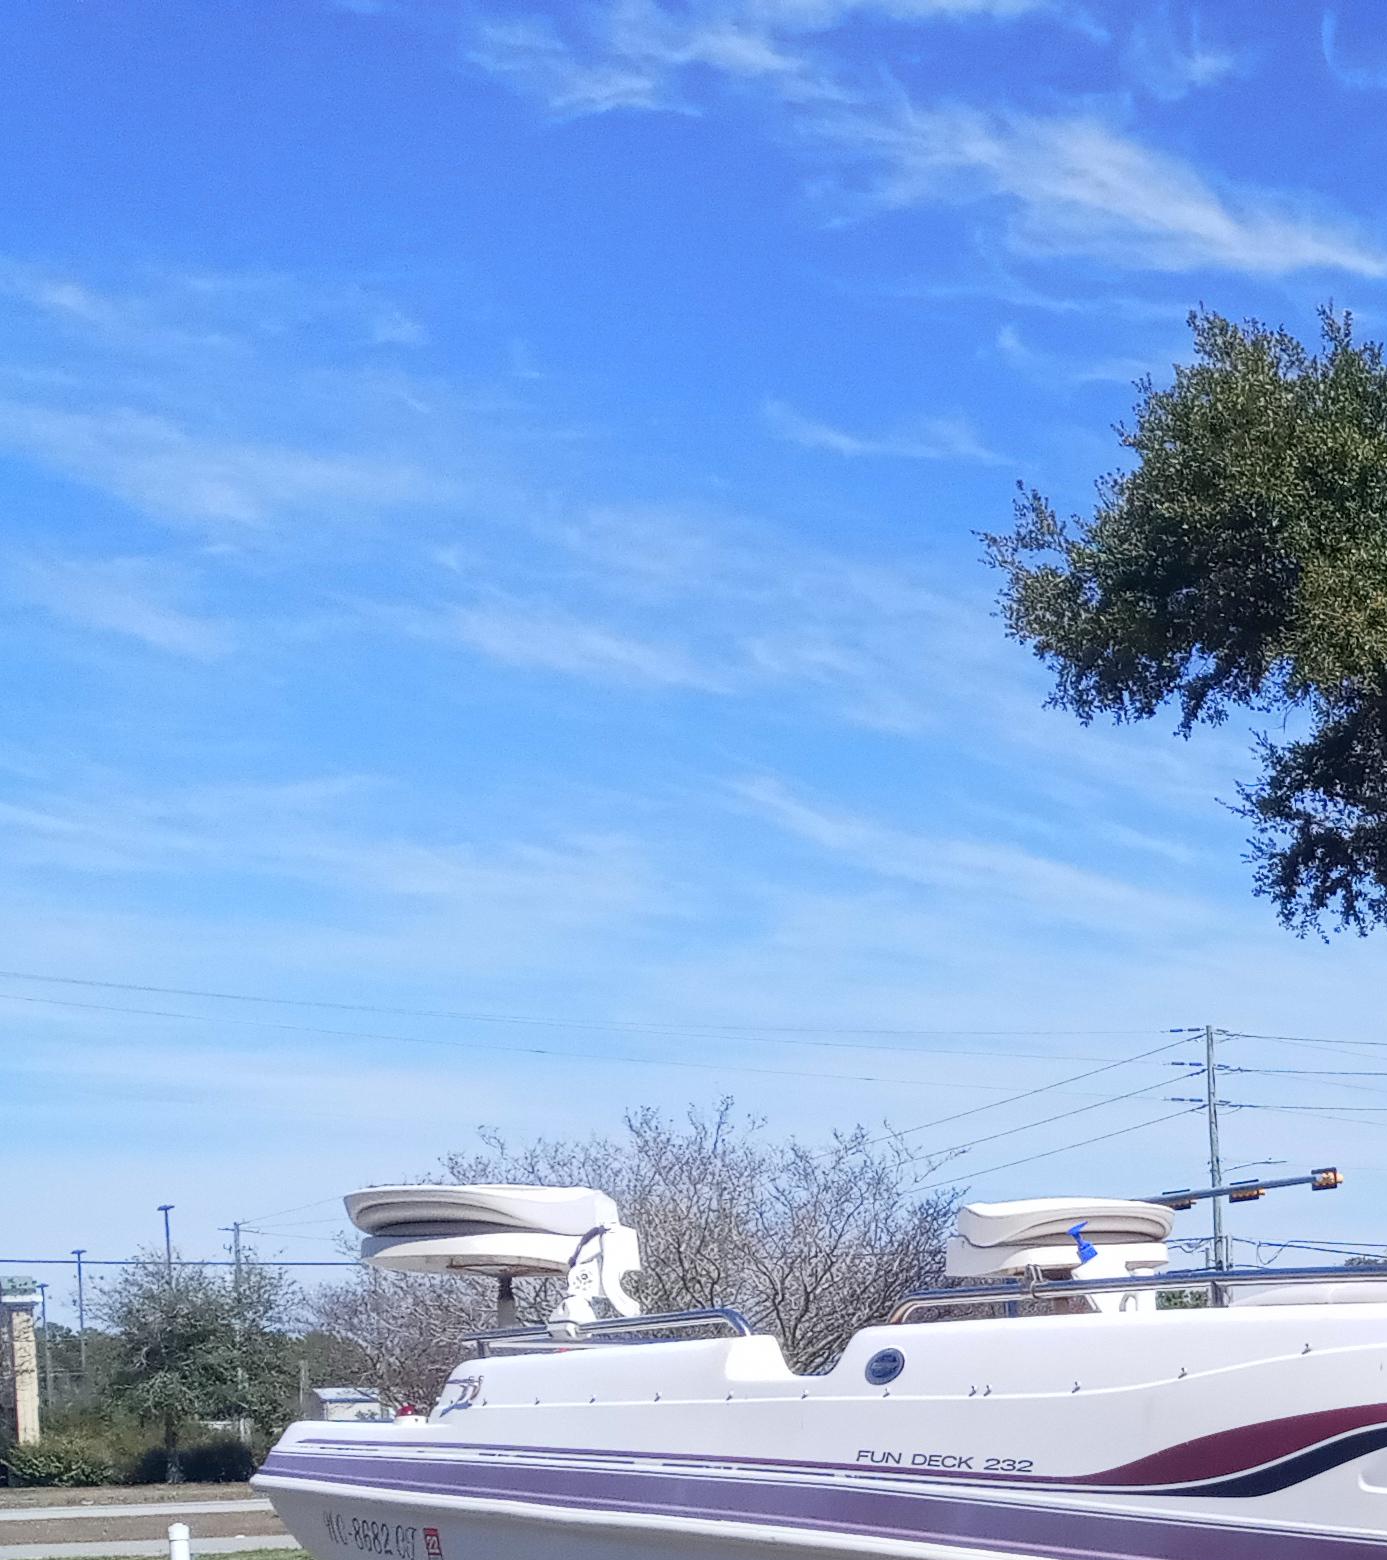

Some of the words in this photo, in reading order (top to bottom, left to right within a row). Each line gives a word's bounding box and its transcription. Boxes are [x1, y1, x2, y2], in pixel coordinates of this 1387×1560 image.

[856, 1450, 902, 1465] FUN
[911, 1453, 974, 1470] DECK
[983, 1458, 1034, 1473] 232
